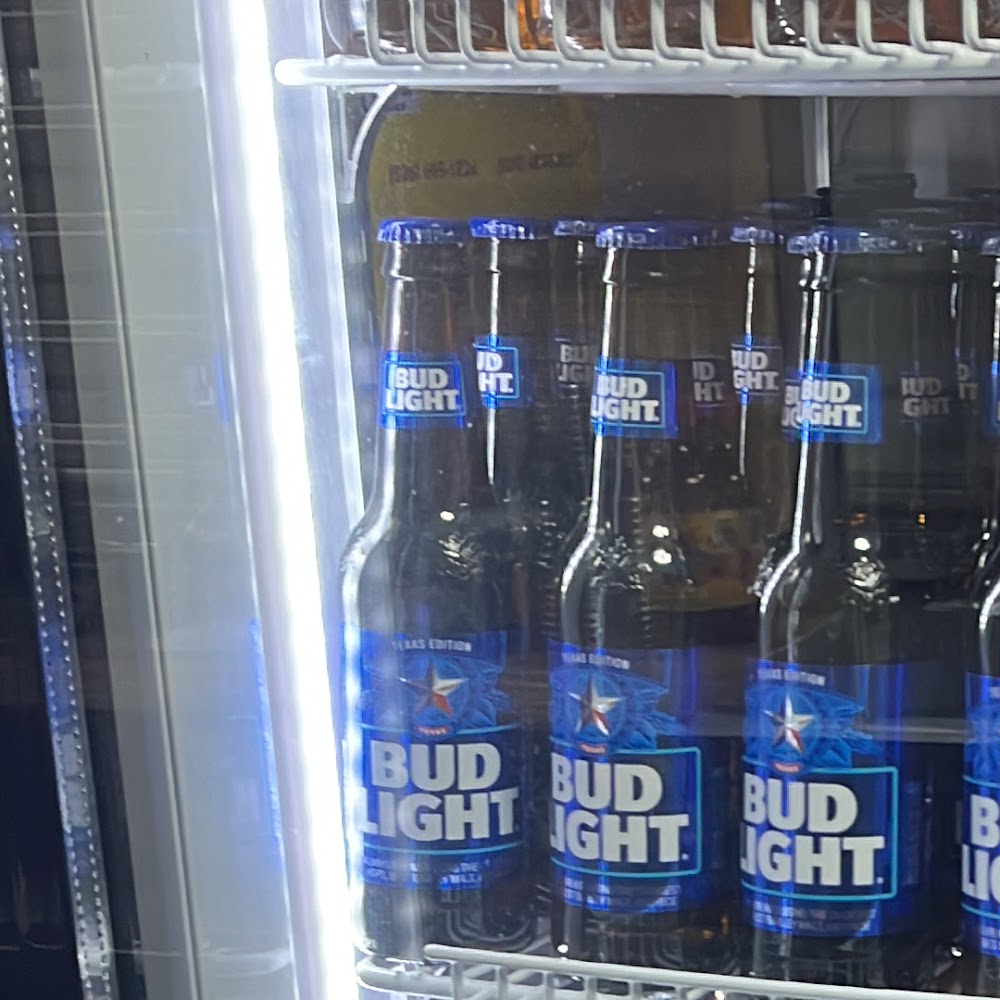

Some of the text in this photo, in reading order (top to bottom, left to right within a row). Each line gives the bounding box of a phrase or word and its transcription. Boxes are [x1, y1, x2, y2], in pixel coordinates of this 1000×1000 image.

[395, 367, 448, 389] BUD
[597, 374, 648, 399] BUD
[733, 369, 779, 391] GHT
[386, 389, 459, 411] LIGHT
[801, 379, 851, 404] BUD
[591, 395, 660, 422] LIGHT
[903, 397, 949, 416] GHT
[370, 740, 501, 791] BUD
[551, 753, 662, 812] BUD
[361, 787, 519, 842] LIGHT
[743, 773, 858, 833] BUD
